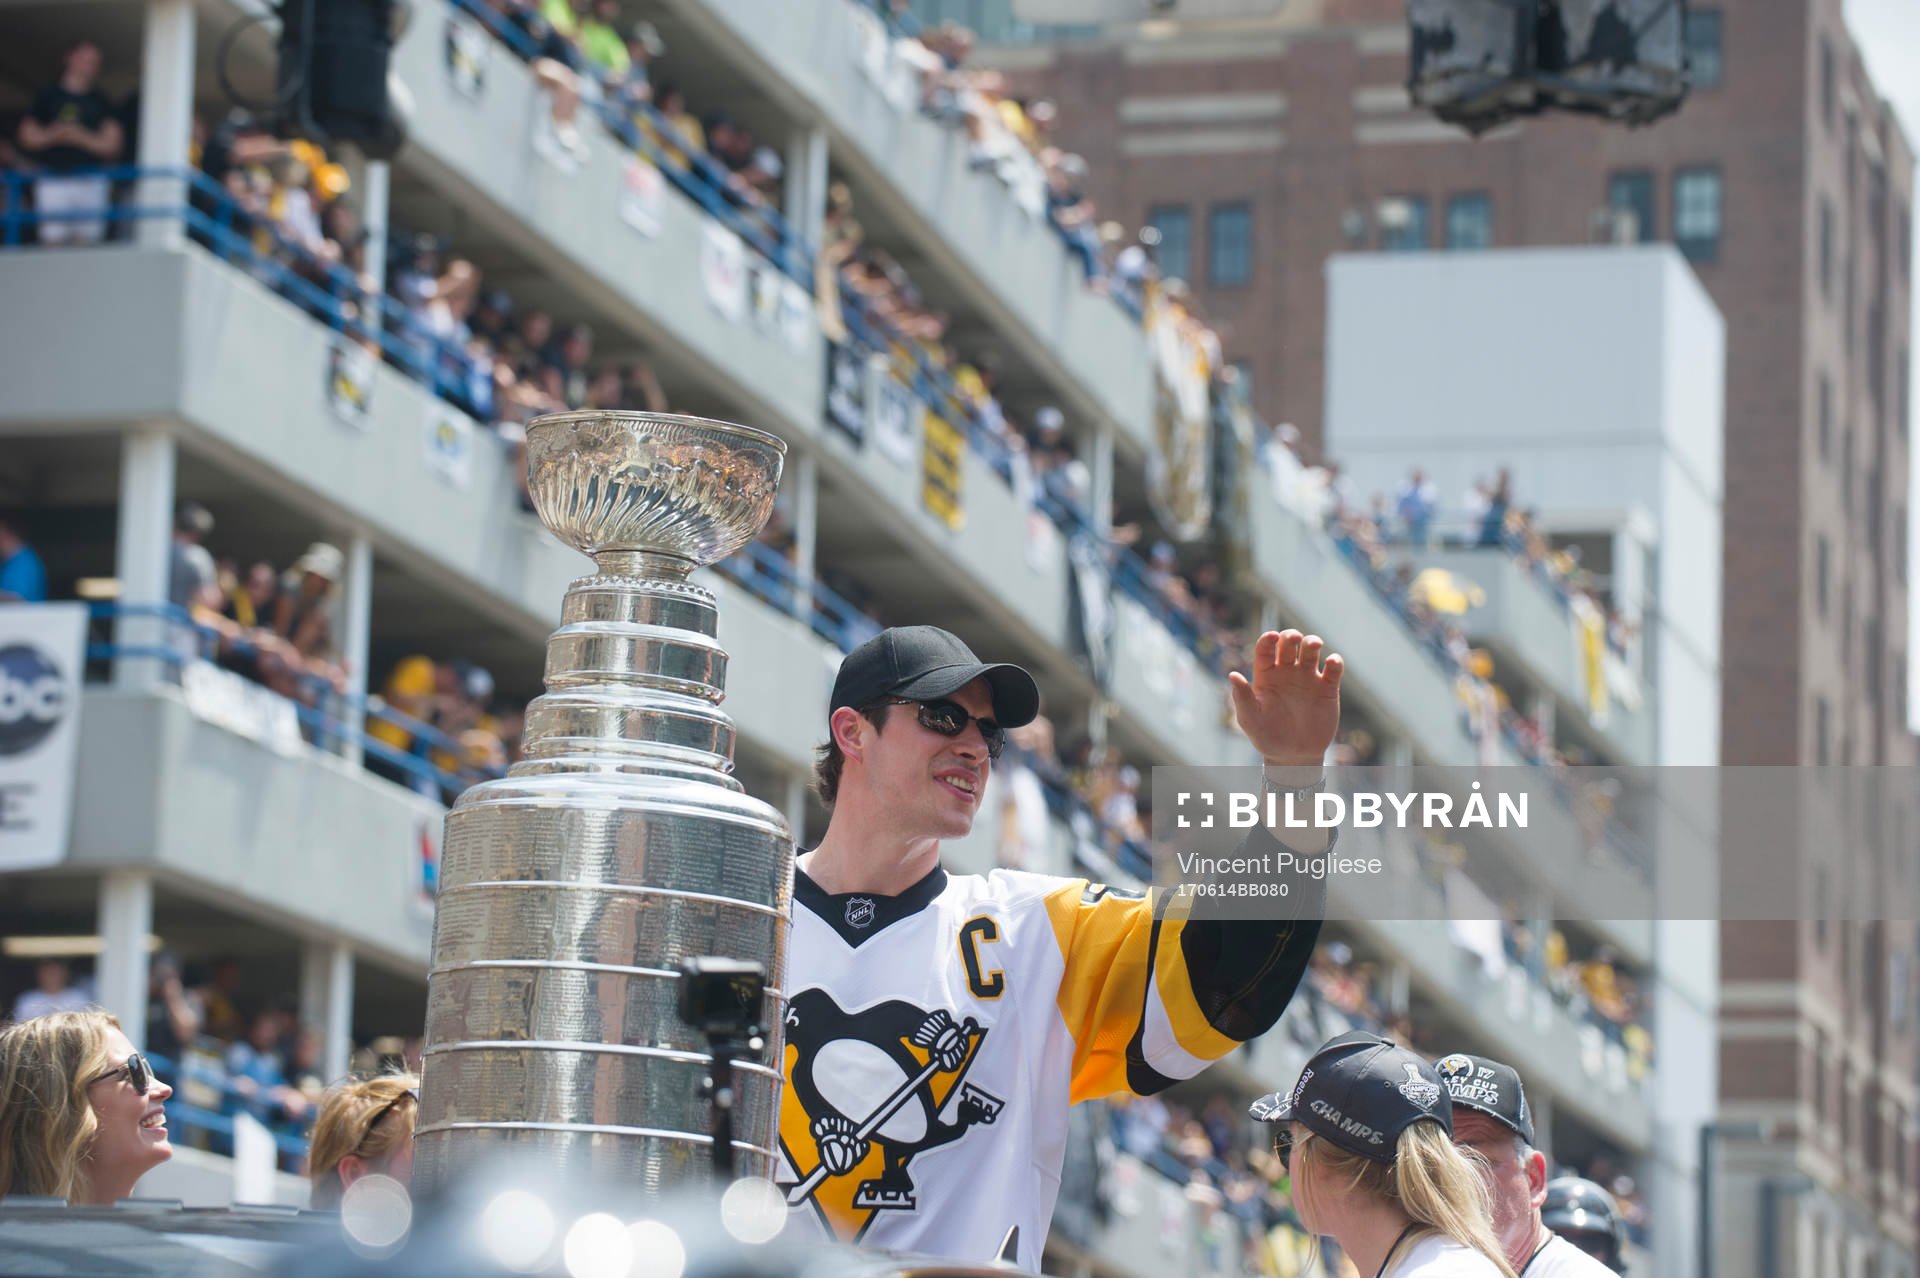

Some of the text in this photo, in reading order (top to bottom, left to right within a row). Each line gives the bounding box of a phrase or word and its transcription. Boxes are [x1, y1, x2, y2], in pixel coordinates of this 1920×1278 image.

[851, 906, 870, 921] NHL
[957, 914, 1006, 1002] C
[1293, 1068, 1315, 1108] Reebok
[1473, 1078, 1498, 1091] CUP
[1310, 1099, 1384, 1145] CHAMPS
